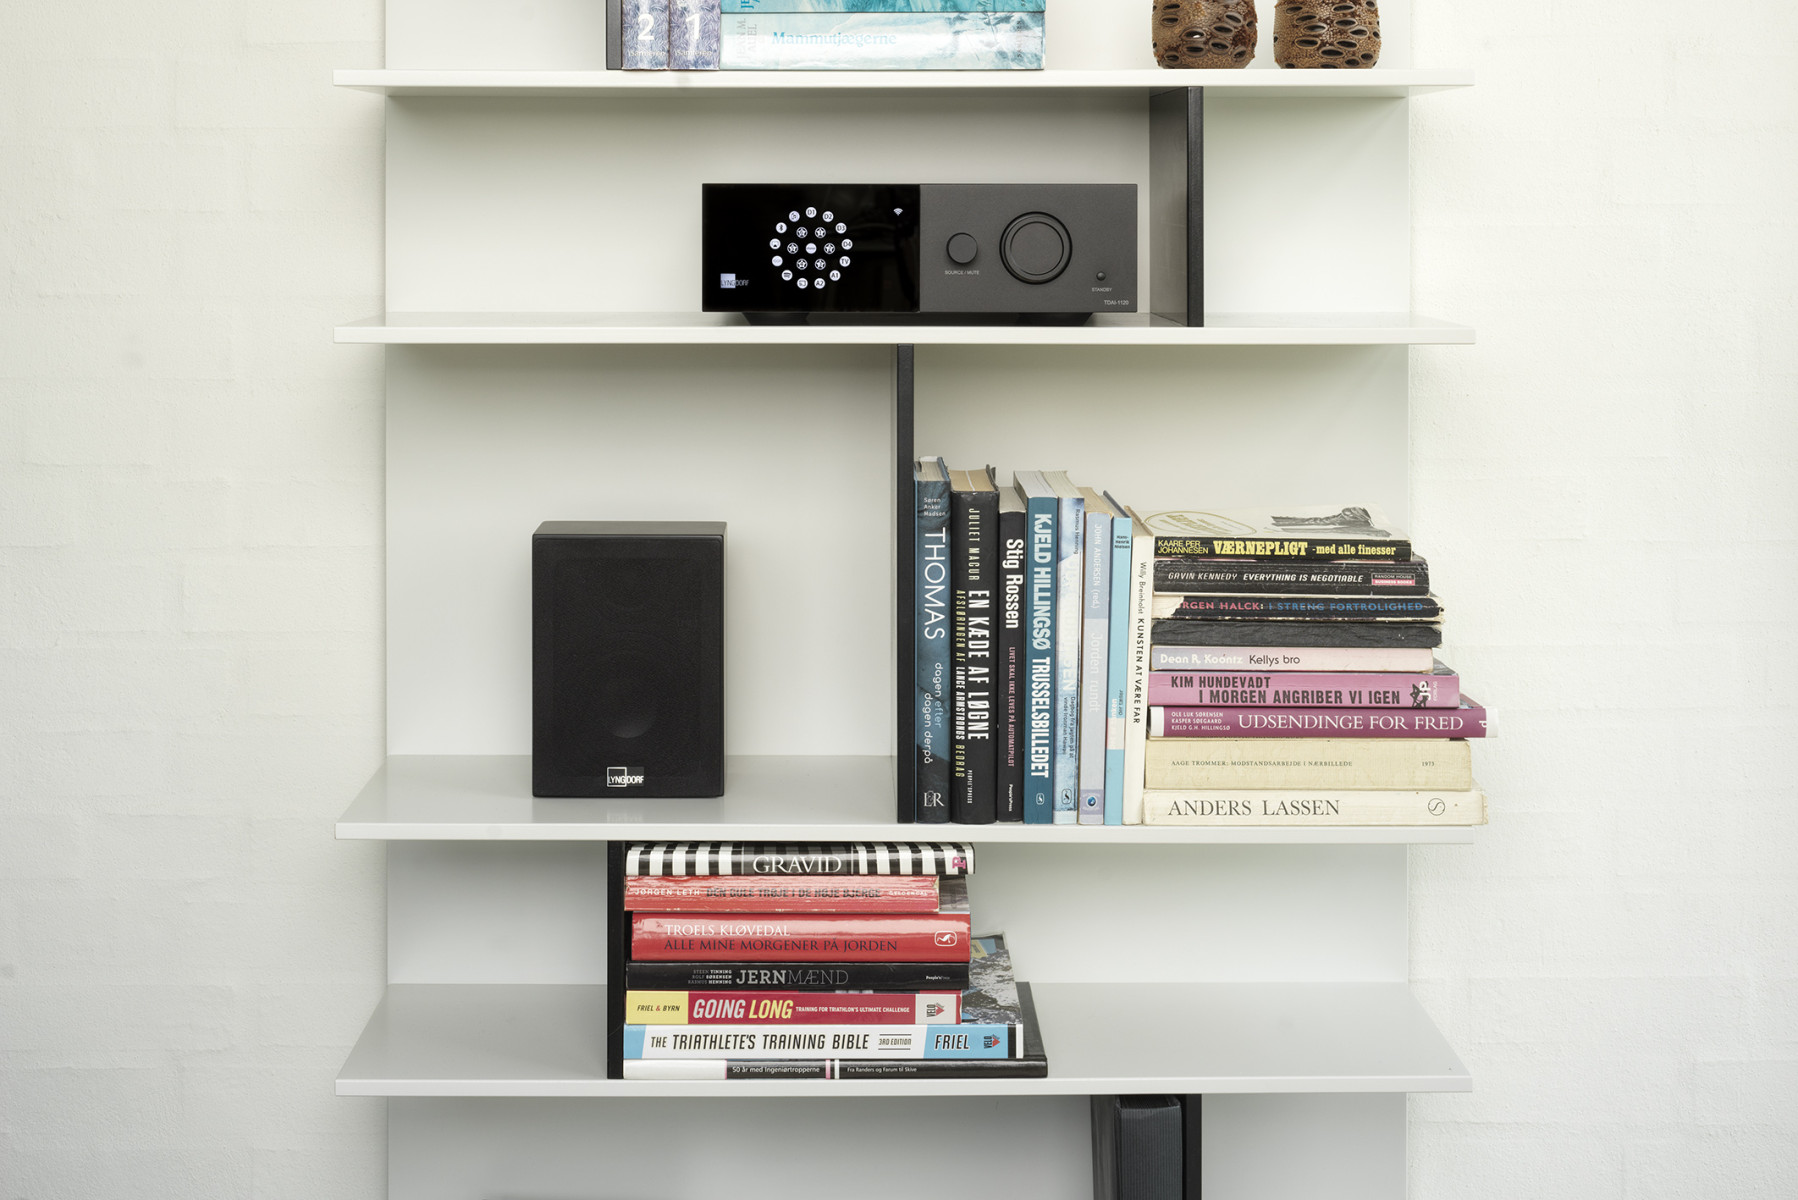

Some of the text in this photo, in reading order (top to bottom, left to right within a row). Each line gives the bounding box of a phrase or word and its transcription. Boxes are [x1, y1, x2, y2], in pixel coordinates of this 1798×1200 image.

[637, 13, 655, 41] 2
[685, 13, 701, 41] 1
[772, 31, 897, 47] Mammutjægerne
[968, 508, 980, 581] JULIET MACUR
[1213, 540, 1308, 556] VÆRNEPLIGT
[1338, 543, 1356, 555] alle
[1357, 544, 1397, 555] finesser
[924, 527, 946, 640] THOMAS
[1002, 538, 1024, 629] Stig Rossen
[1168, 572, 1196, 580] GAVIN
[1197, 572, 1238, 580] KENNEDY
[1243, 573, 1297, 581] EVERYTHING
[1310, 574, 1364, 583] NEGOTIABLE
[1030, 513, 1052, 778] KJELD HILLINGSØ TRUSSELSBILLEDET
[1133, 561, 1147, 724] Willy Breinholst KUNSTEN AT VÆRE FAR
[967, 590, 990, 740] EN KÆDE AF LØGNE
[1160, 653, 1301, 667] Dean R. Koontz Kellys bro
[1089, 632, 1103, 712] Jorden rundt
[955, 590, 966, 778] AFSLØRINGEN AF LANCE ARMSTRONGS BEDRAG
[1171, 675, 1271, 689] KIM HUNDEVADT
[932, 662, 944, 728] dagen efter
[1199, 689, 1400, 705] I MORGEN ANGRIBER VI IGEN
[922, 692, 934, 764] dagen derpå
[1238, 714, 1464, 730] UDSENDINGE FOR FRED
[608, 775, 644, 784] LYNGDORF
[1167, 800, 1340, 816] ANDERS LASSEN
[752, 855, 842, 874] GRAVID
[664, 924, 791, 937] TROELS KLØVEDAL
[664, 937, 898, 953] ALLE MINE MORGENER PÅ JORDEN
[736, 969, 849, 985] JERNMÆND
[636, 1004, 654, 1012] FRIEL
[662, 1004, 680, 1012] BYRN
[693, 999, 746, 1019] GOING
[748, 999, 794, 1019] LONG
[651, 1033, 970, 1051] THE TRIATHLETE'S TRAINING BIBLE 3RD EDITION FRIEL
